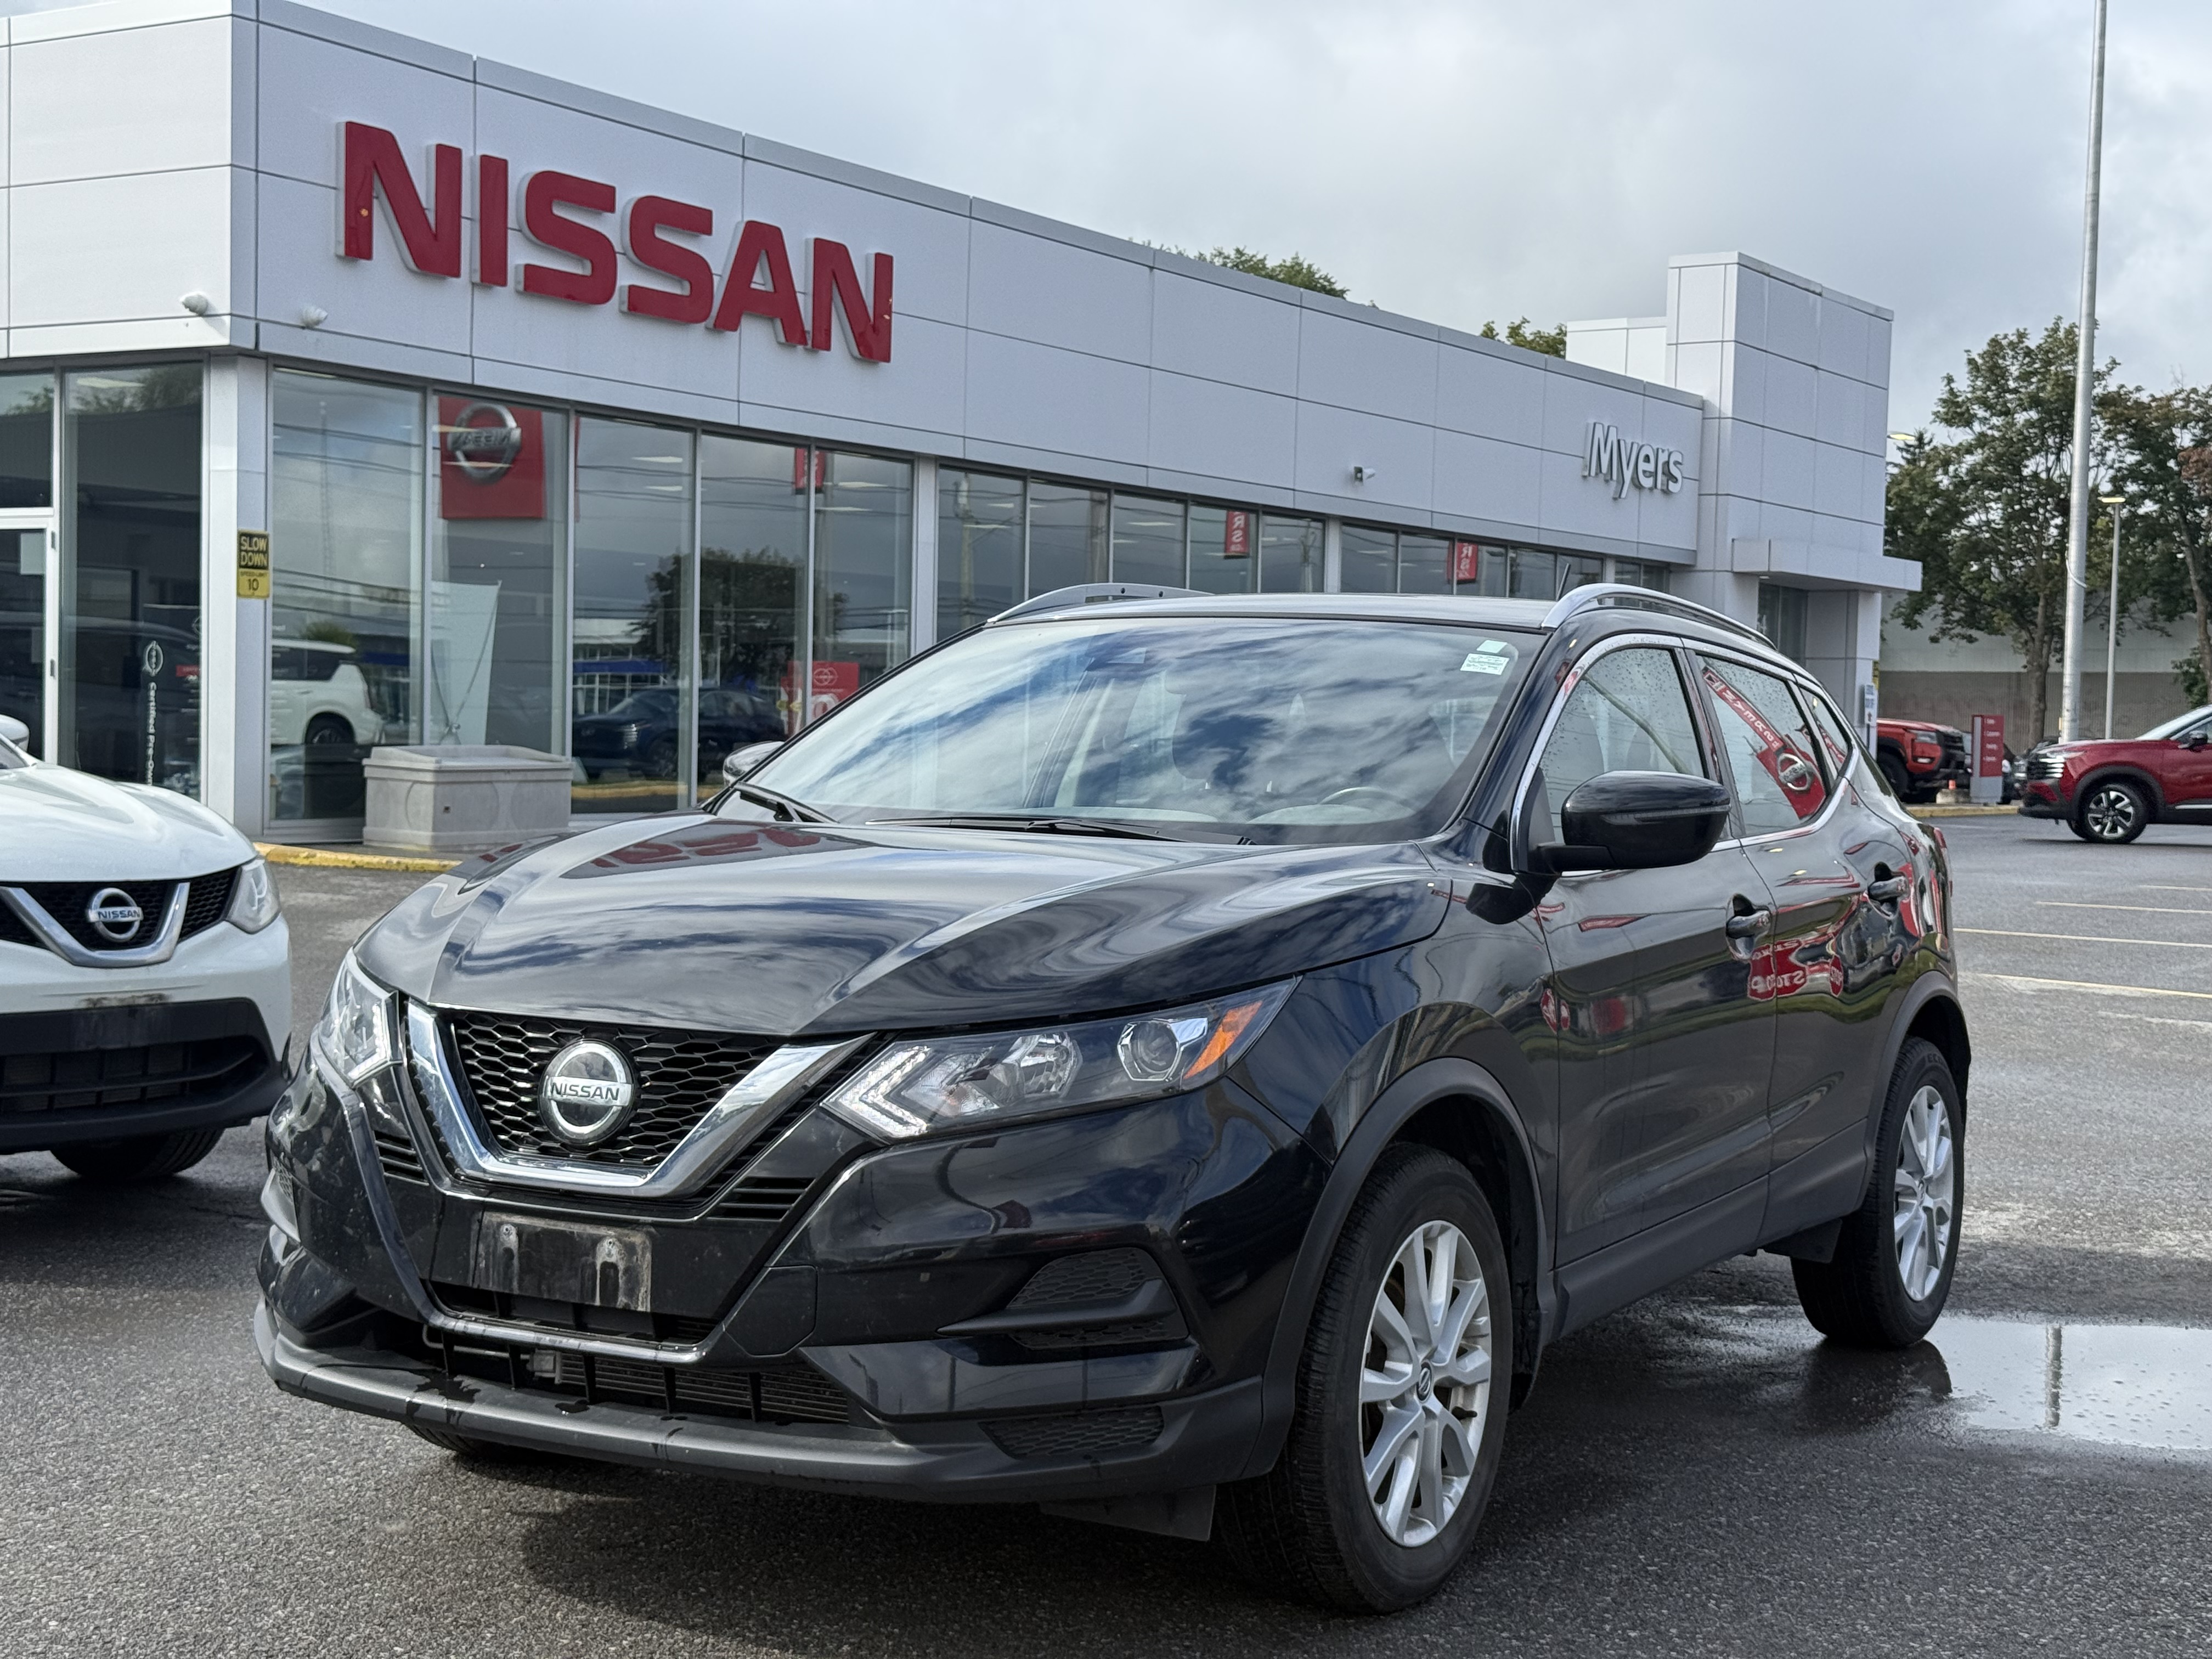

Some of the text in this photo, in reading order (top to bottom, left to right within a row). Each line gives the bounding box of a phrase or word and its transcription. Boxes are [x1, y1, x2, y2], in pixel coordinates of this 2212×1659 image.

[339, 120, 894, 363] NISSAN
[1586, 421, 1684, 500] Myers
[240, 536, 267, 551] SLOW
[240, 551, 267, 567] DOWN
[248, 578, 259, 591] 10
[98, 910, 140, 918] NISSAN
[550, 1082, 620, 1101] NISSAN
